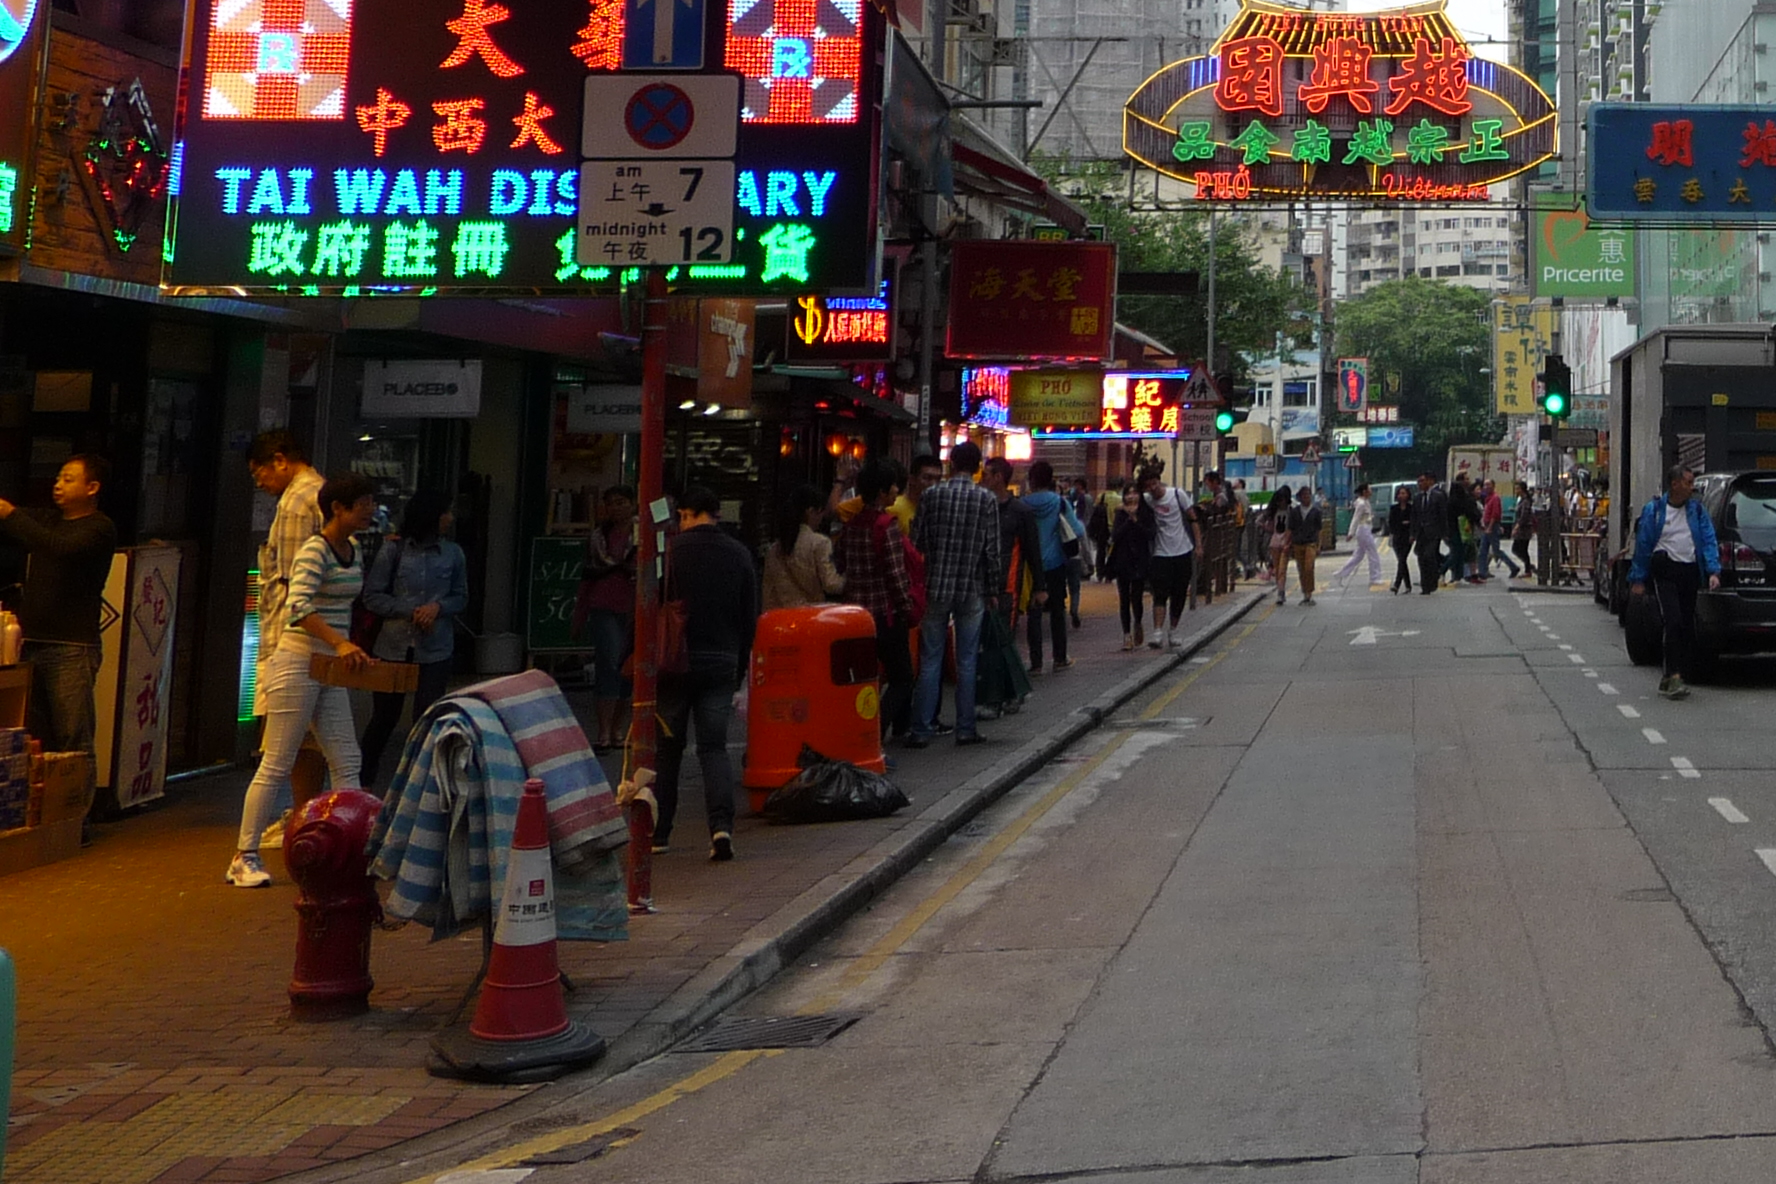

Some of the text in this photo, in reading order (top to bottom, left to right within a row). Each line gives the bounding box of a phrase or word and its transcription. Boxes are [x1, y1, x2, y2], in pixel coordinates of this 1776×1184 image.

[615, 166, 642, 178] am
[215, 167, 313, 215] TAI
[332, 167, 464, 215] WAH
[604, 182, 651, 202] 上午
[679, 166, 704, 202] 7
[585, 221, 667, 239] midnight
[602, 240, 649, 261] 午夜
[678, 226, 725, 262] 12
[1543, 265, 1625, 284] Pricerite
[383, 382, 459, 397] PLACEBO
